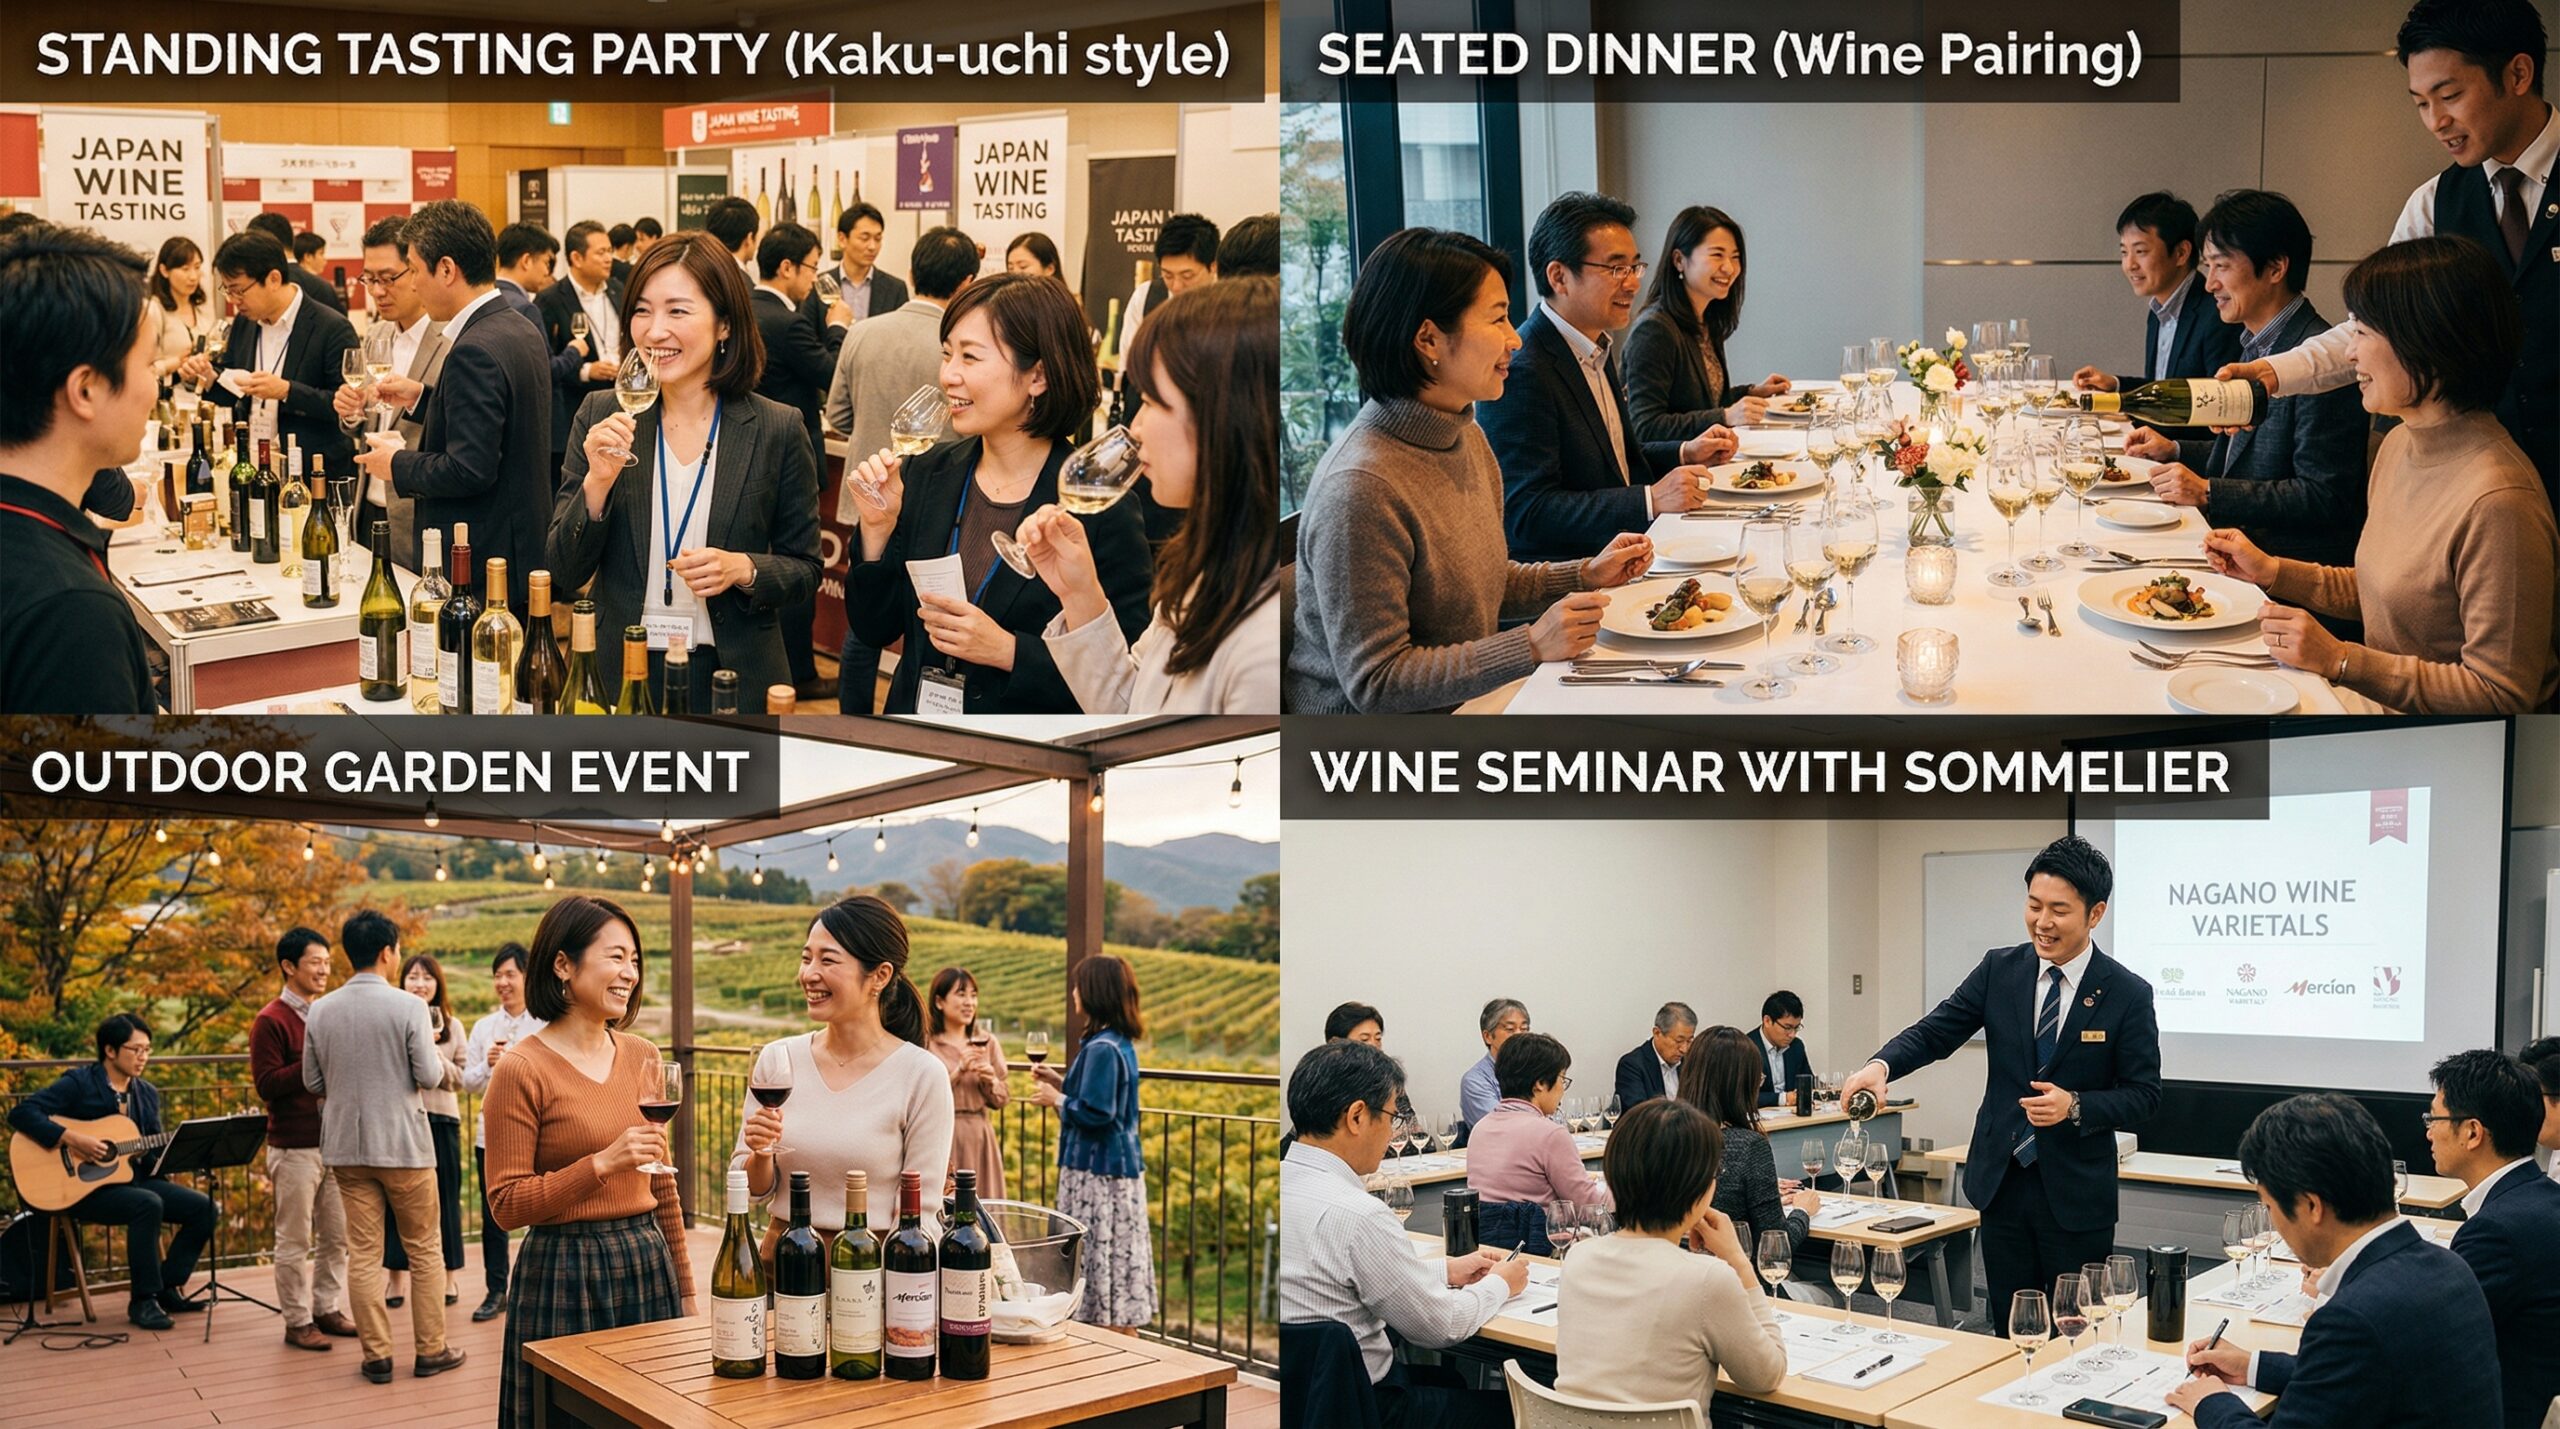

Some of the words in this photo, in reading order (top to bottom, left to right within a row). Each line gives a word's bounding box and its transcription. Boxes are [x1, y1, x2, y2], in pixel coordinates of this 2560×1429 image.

[72, 137, 183, 162] JAPAN
[973, 139, 1049, 165] JAPAN
[73, 167, 184, 196] WINE
[974, 169, 1048, 196] WINE
[74, 202, 187, 221] TASTING
[973, 202, 1048, 220] TASTING
[1111, 209, 1164, 226] JAPAN
[1115, 227, 1161, 243] TASTI
[2169, 881, 2277, 906] NAGANO
[2286, 879, 2357, 904] WINE
[2191, 914, 2329, 937] VARIETALS
[2226, 988, 2268, 997] NAGANO
